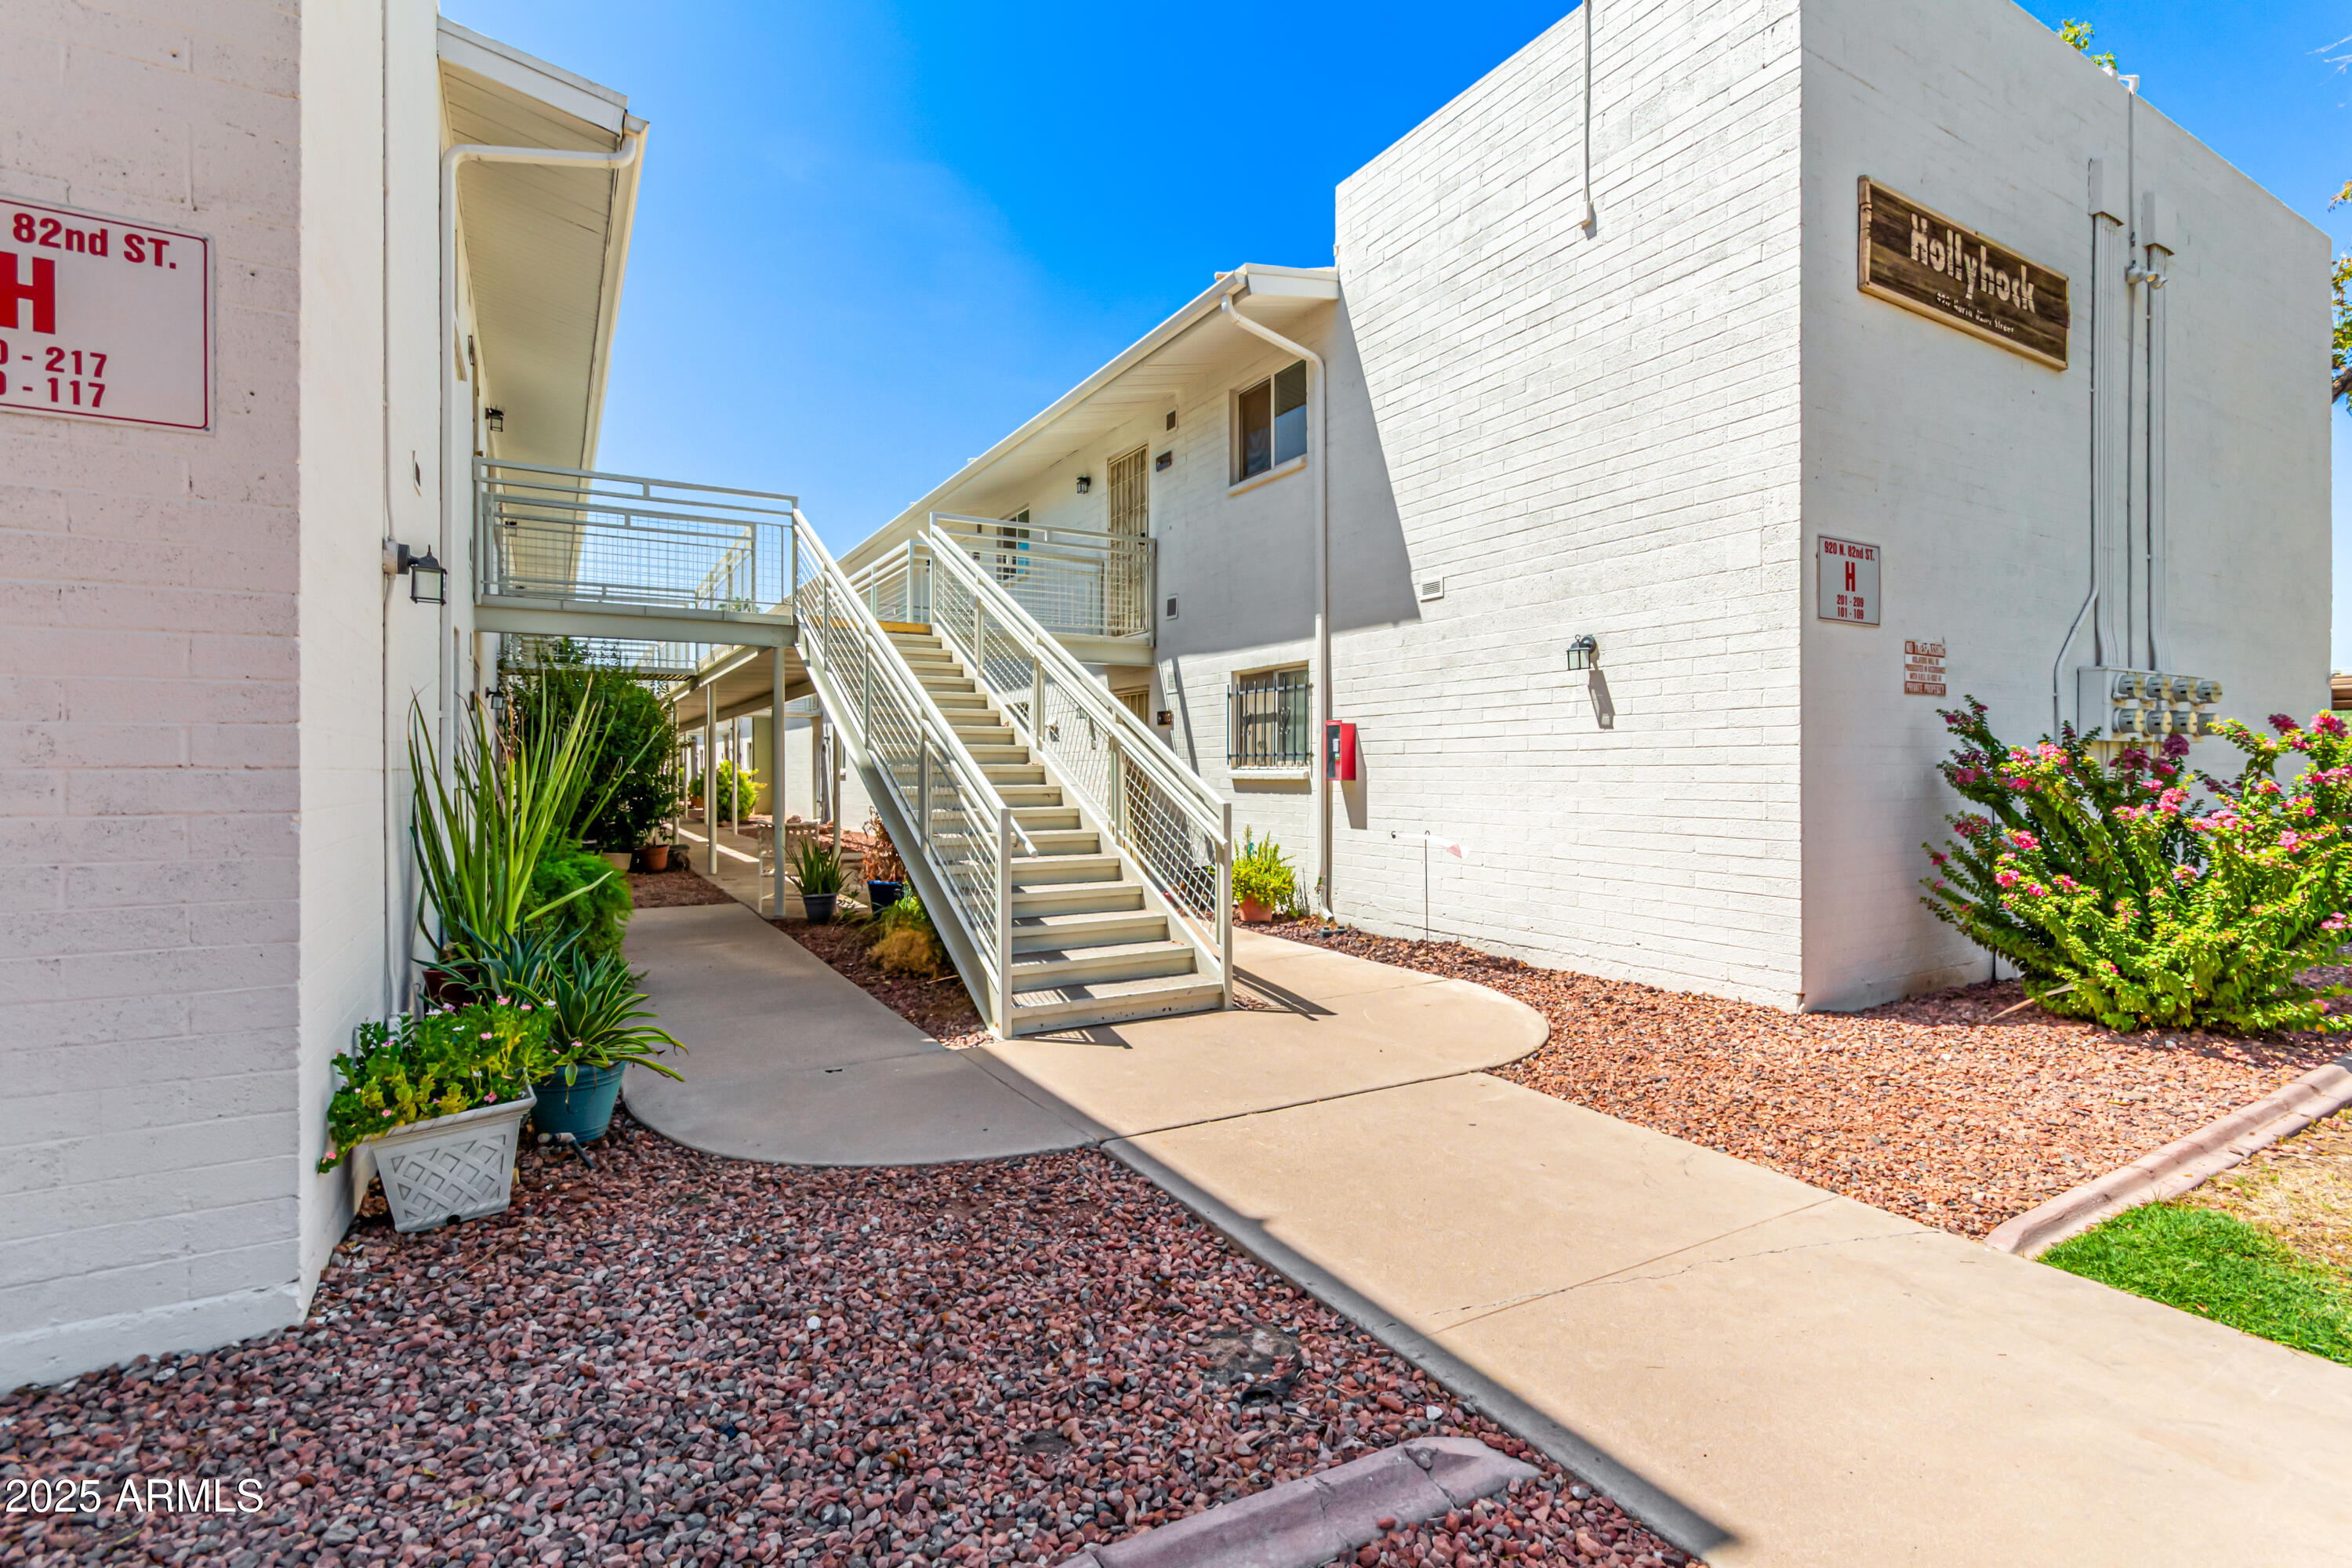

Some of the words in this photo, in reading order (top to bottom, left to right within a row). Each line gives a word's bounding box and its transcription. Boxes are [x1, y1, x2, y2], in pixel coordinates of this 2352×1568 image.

[13, 212, 109, 257] 82nd
[123, 234, 176, 270] ST.
[1910, 212, 2036, 314] Hollyhock
[0, 250, 56, 336] H
[45, 346, 107, 379] 217
[47, 377, 106, 408] 117
[1824, 540, 1838, 555] 920
[1839, 543, 1846, 557] N.
[1848, 545, 1864, 560] 82nd
[1865, 548, 1875, 561] ST.
[1845, 561, 1856, 593] H
[1837, 593, 1848, 606] 201
[1853, 596, 1864, 608] 209
[1838, 606, 1848, 619] 101
[1853, 608, 1864, 620] 109
